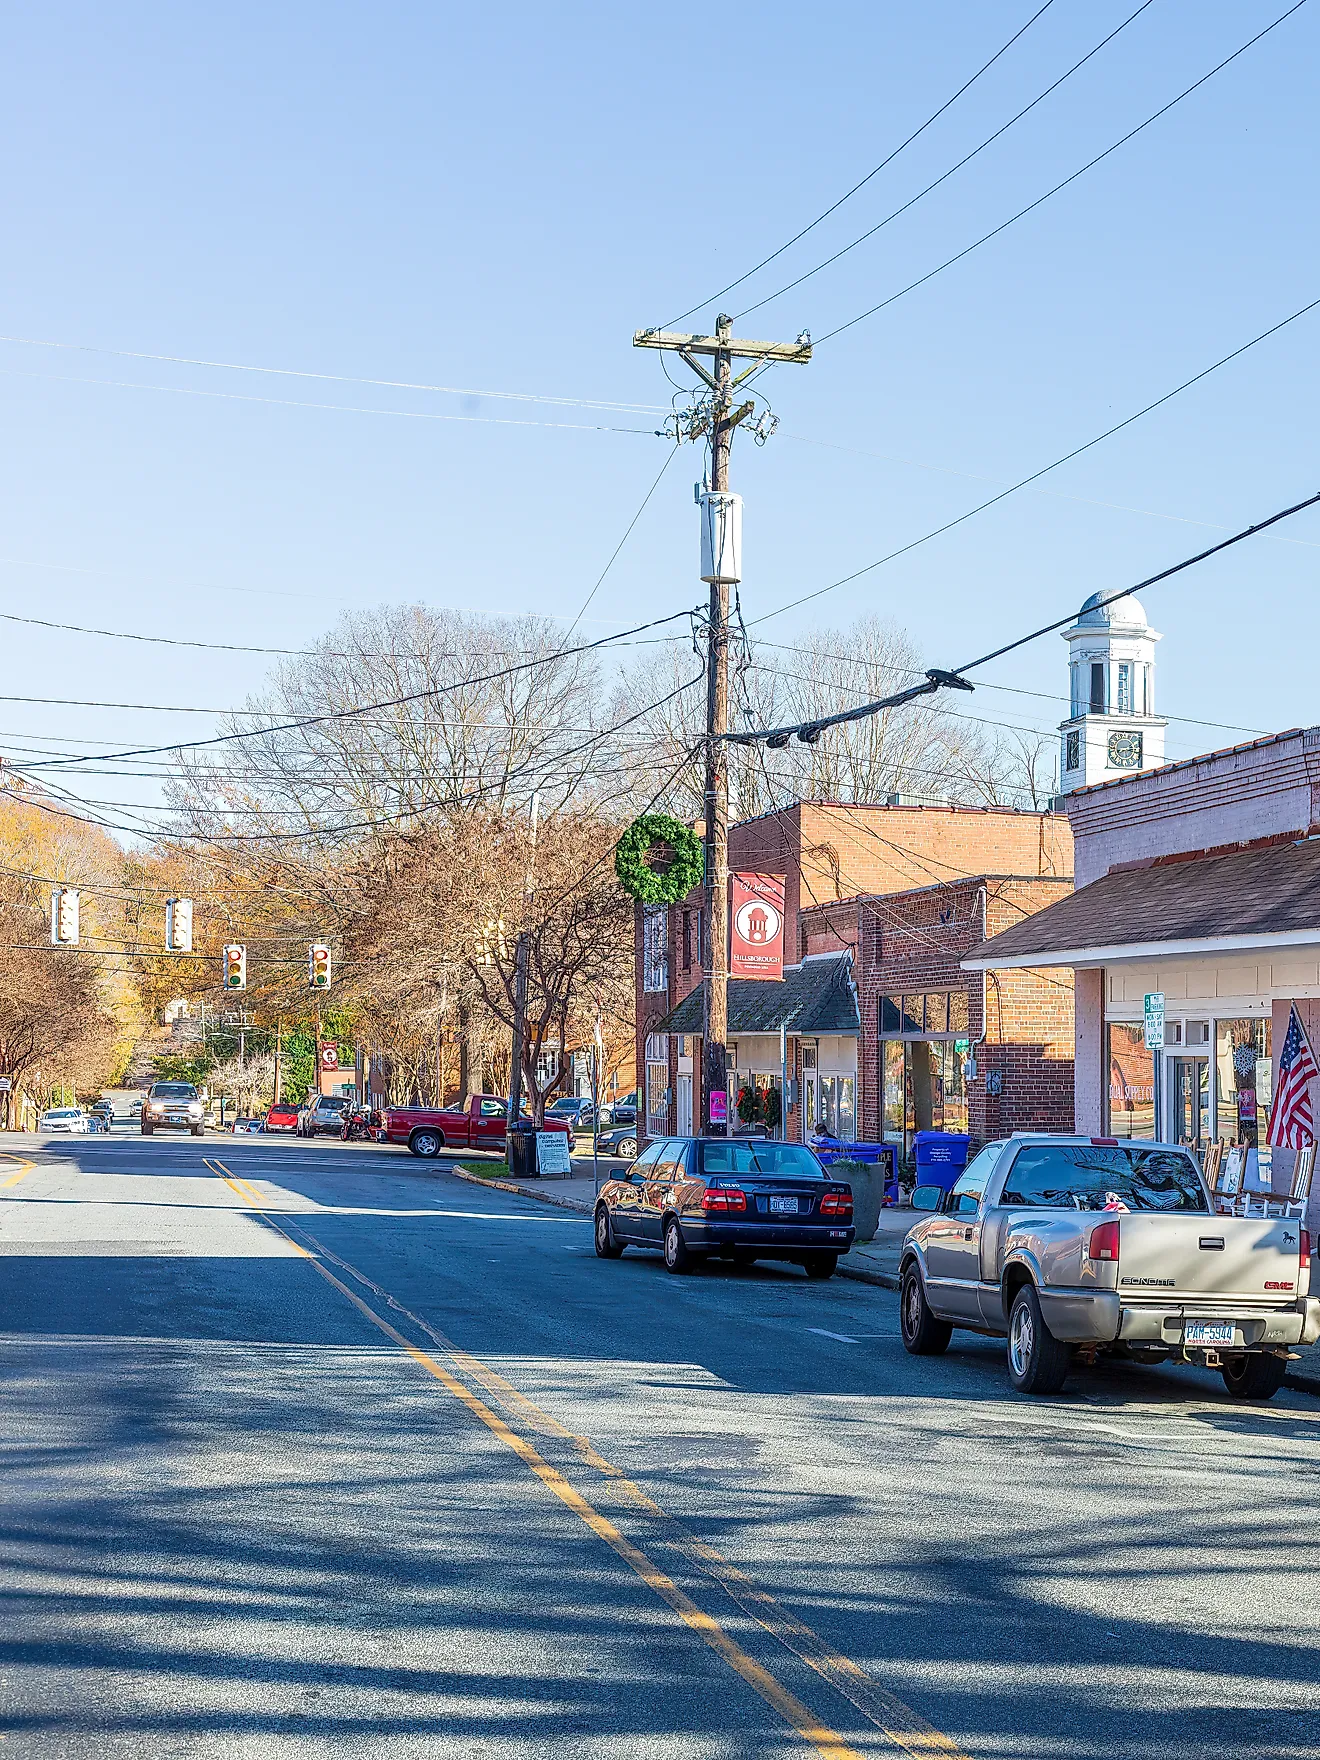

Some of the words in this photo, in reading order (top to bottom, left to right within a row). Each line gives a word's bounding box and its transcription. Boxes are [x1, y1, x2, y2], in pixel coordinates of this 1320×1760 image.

[733, 954, 781, 963] HILLSBOROUGH
[1263, 1281, 1294, 1290] GMC
[1186, 1325, 1233, 1340] PAM-5944
